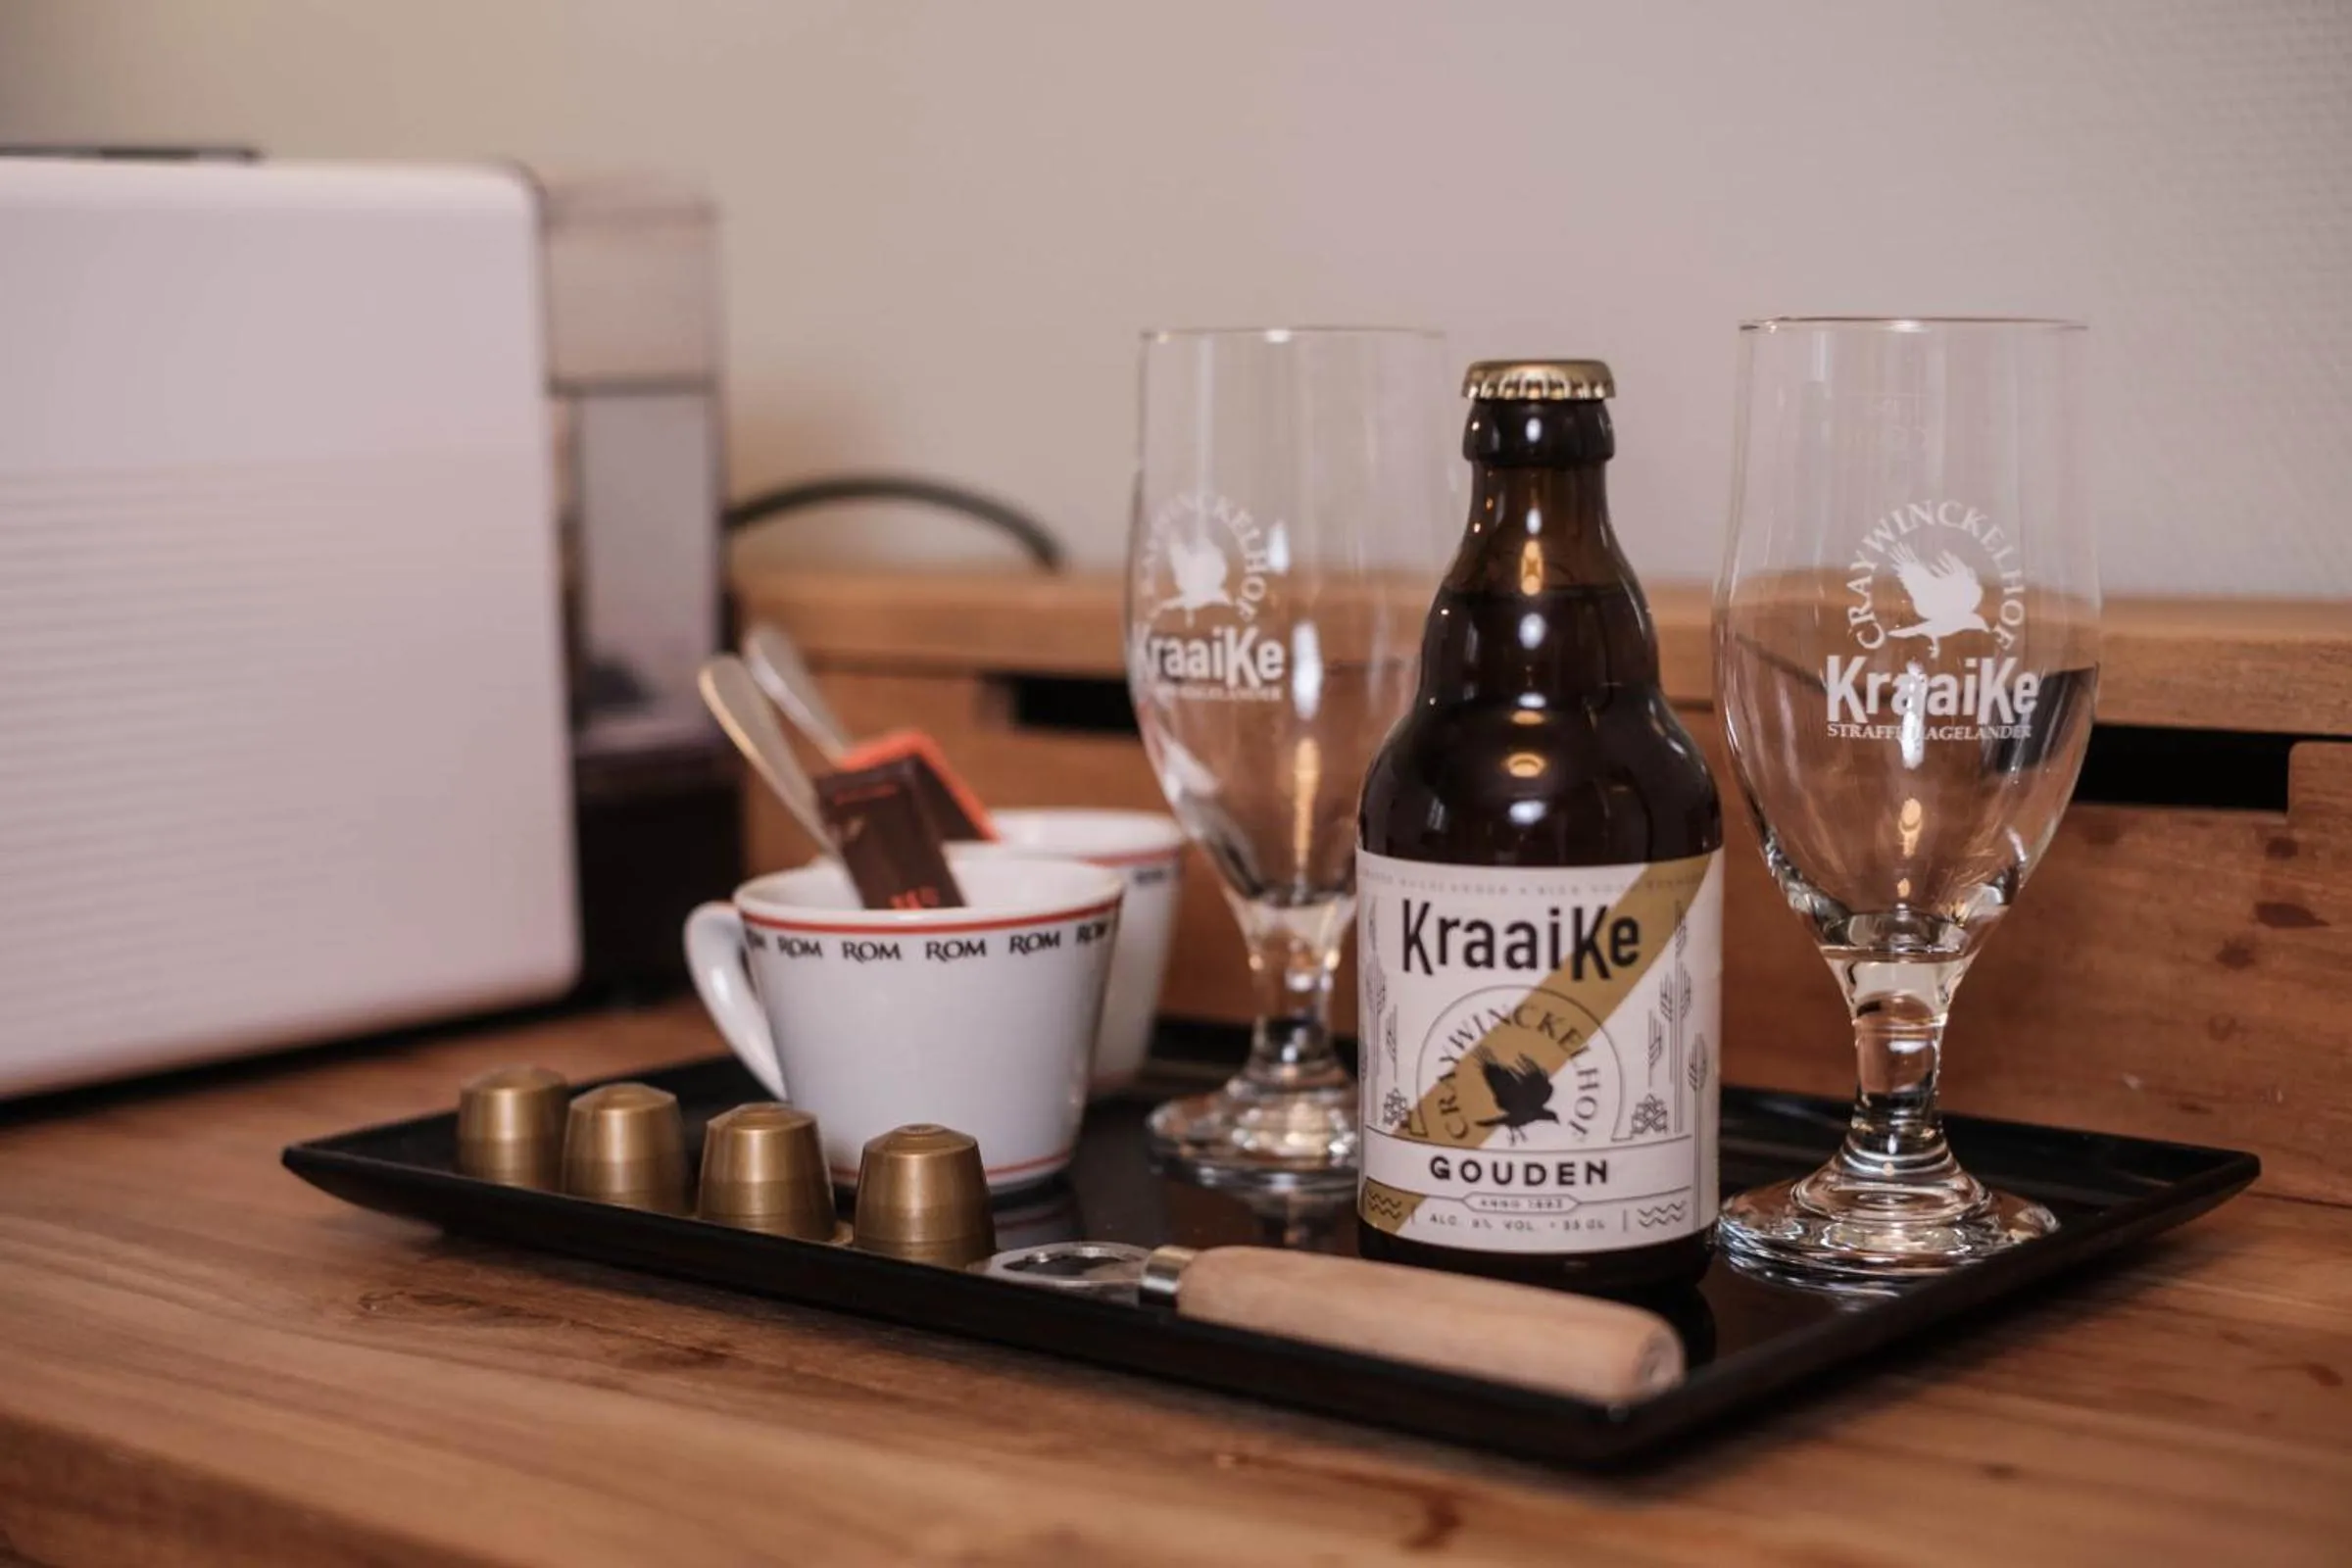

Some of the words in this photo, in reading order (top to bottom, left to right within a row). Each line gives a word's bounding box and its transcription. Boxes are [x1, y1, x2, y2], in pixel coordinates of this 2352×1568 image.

[1847, 500, 2026, 651] CRAYWINCKELHOF
[1826, 655, 2039, 723] KraaiKe
[1827, 722, 1903, 740] STRAFF
[1915, 722, 2033, 741] AGELANDER
[777, 934, 823, 959] ROM
[841, 940, 902, 963] ROM
[925, 938, 987, 962] ROM
[1008, 931, 1061, 956] ROM
[1402, 898, 1641, 981] KraaiKe
[1437, 1002, 1600, 1142] CRAYWINCKELHOF
[1429, 1155, 1608, 1186] GOUDEN
